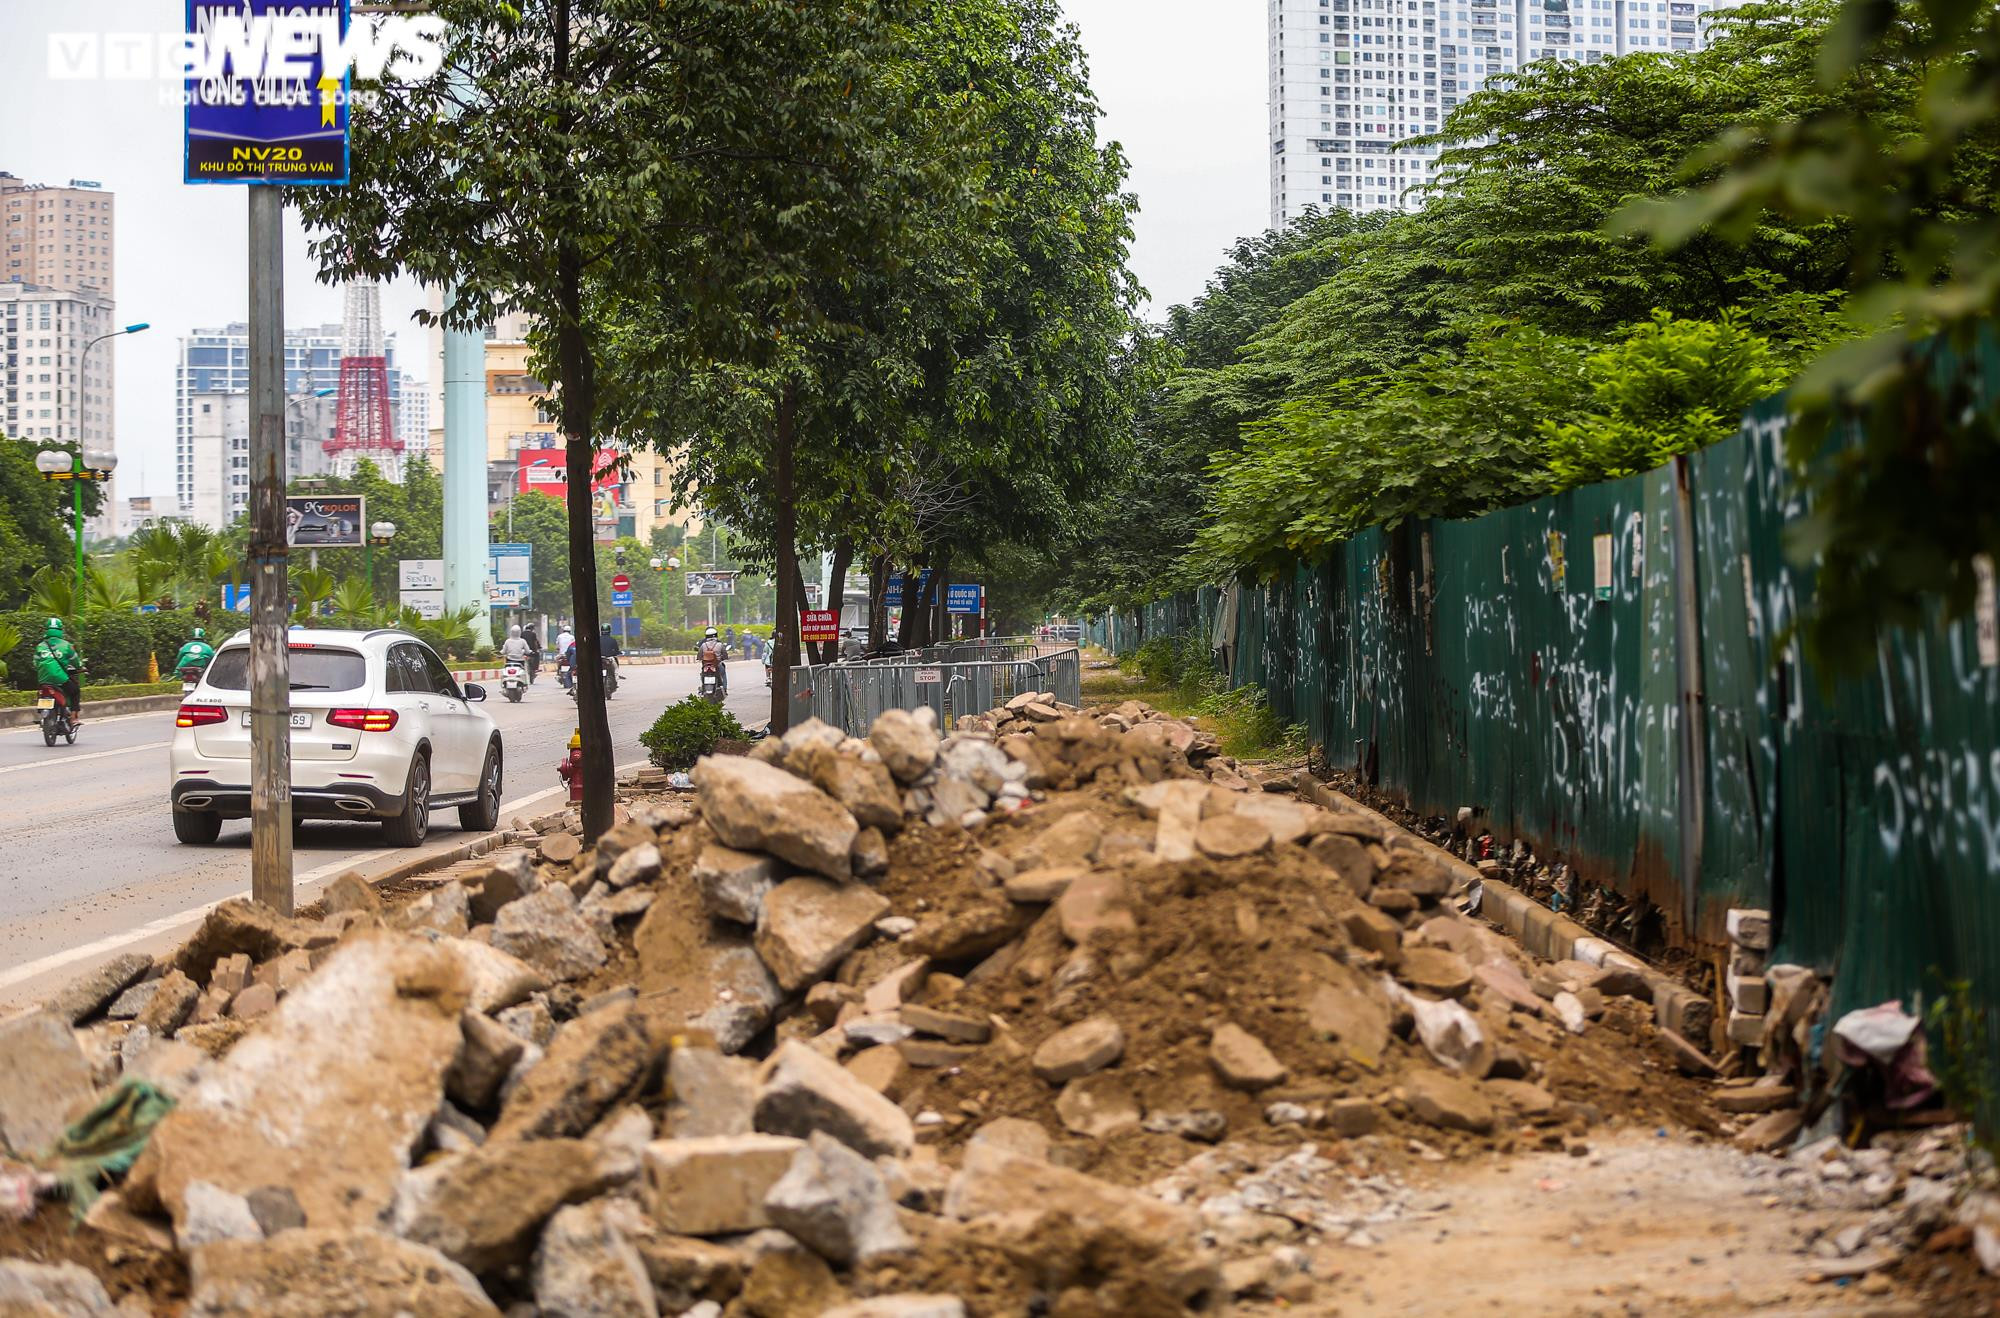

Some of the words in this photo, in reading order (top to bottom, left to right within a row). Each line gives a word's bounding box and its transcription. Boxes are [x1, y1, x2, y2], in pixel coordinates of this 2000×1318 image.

[233, 147, 303, 161] NV20
[200, 162, 224, 172] KHU
[247, 162, 265, 174] THỊ
[268, 162, 307, 172] TRUNG
[310, 161, 334, 172] VĂN
[501, 589, 515, 597] PTI
